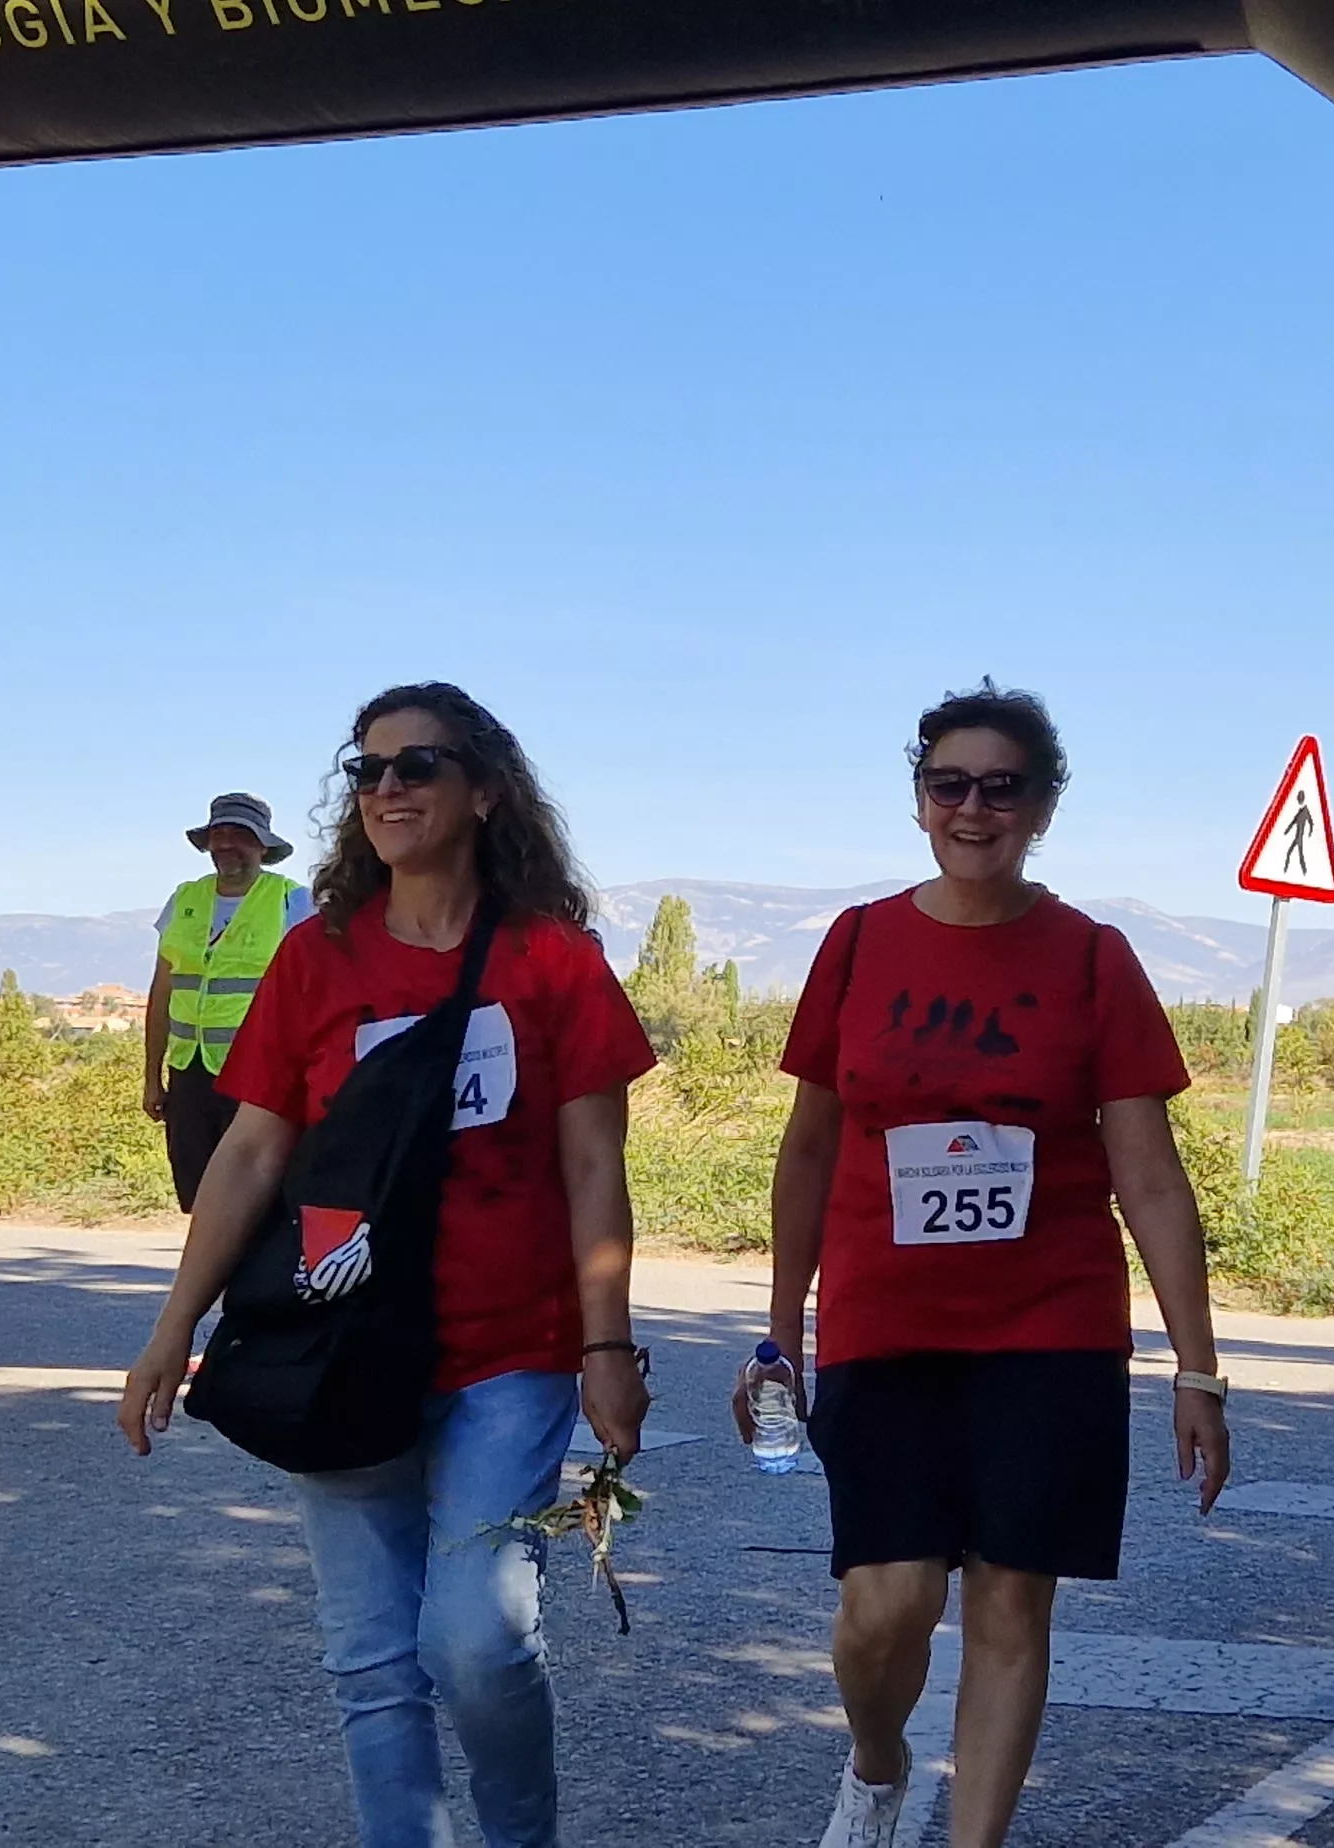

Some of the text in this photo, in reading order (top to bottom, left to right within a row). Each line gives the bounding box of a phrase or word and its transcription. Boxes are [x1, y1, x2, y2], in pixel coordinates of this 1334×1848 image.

[144, 0, 176, 35] Y
[457, 1073, 489, 1115] 4
[921, 1186, 1015, 1234] 255
